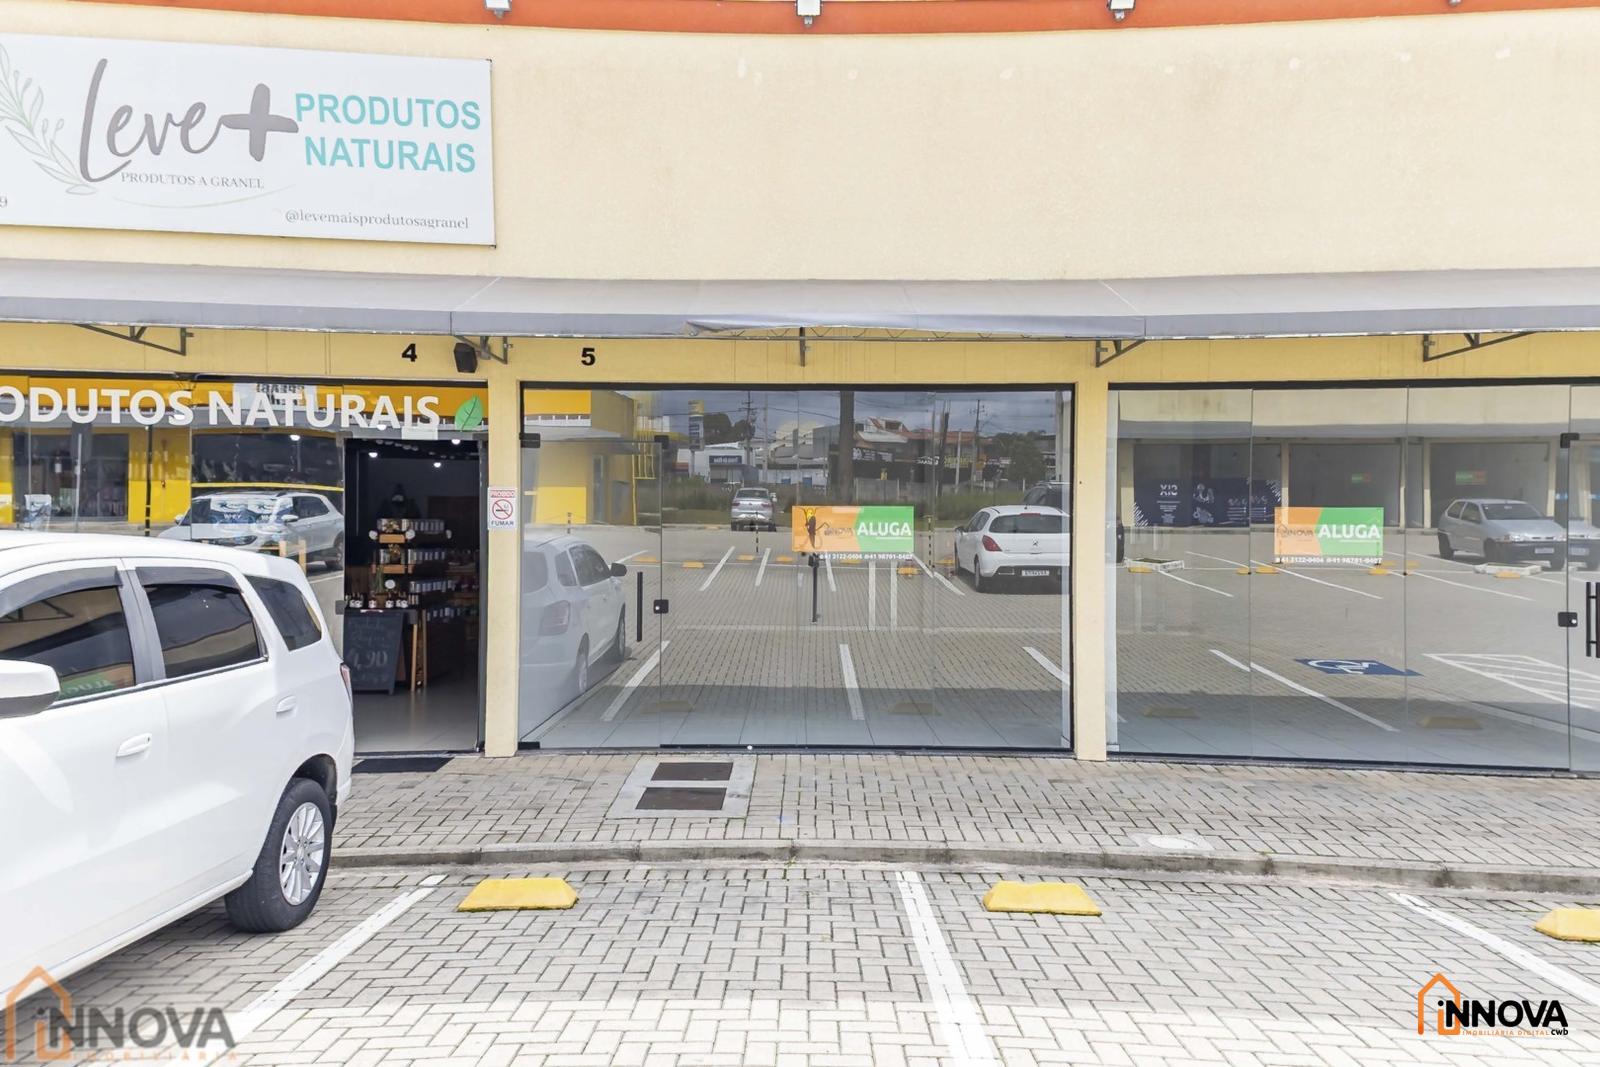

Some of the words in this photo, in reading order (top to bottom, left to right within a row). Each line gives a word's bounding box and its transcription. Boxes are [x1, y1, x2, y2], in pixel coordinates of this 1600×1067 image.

[295, 93, 481, 130] PRODUTOS
[304, 135, 476, 173] NATURAIS
[120, 171, 196, 186] PRODUTOS
[198, 177, 209, 186] A
[210, 177, 265, 189] GRANEL
[285, 209, 469, 230] @levemaisprodutosagranel
[401, 343, 418, 363] 4
[581, 347, 596, 367] 5
[208, 390, 440, 429] NATURAIS
[856, 521, 912, 537] ALUGA
[1317, 524, 1381, 539] ALUGA
